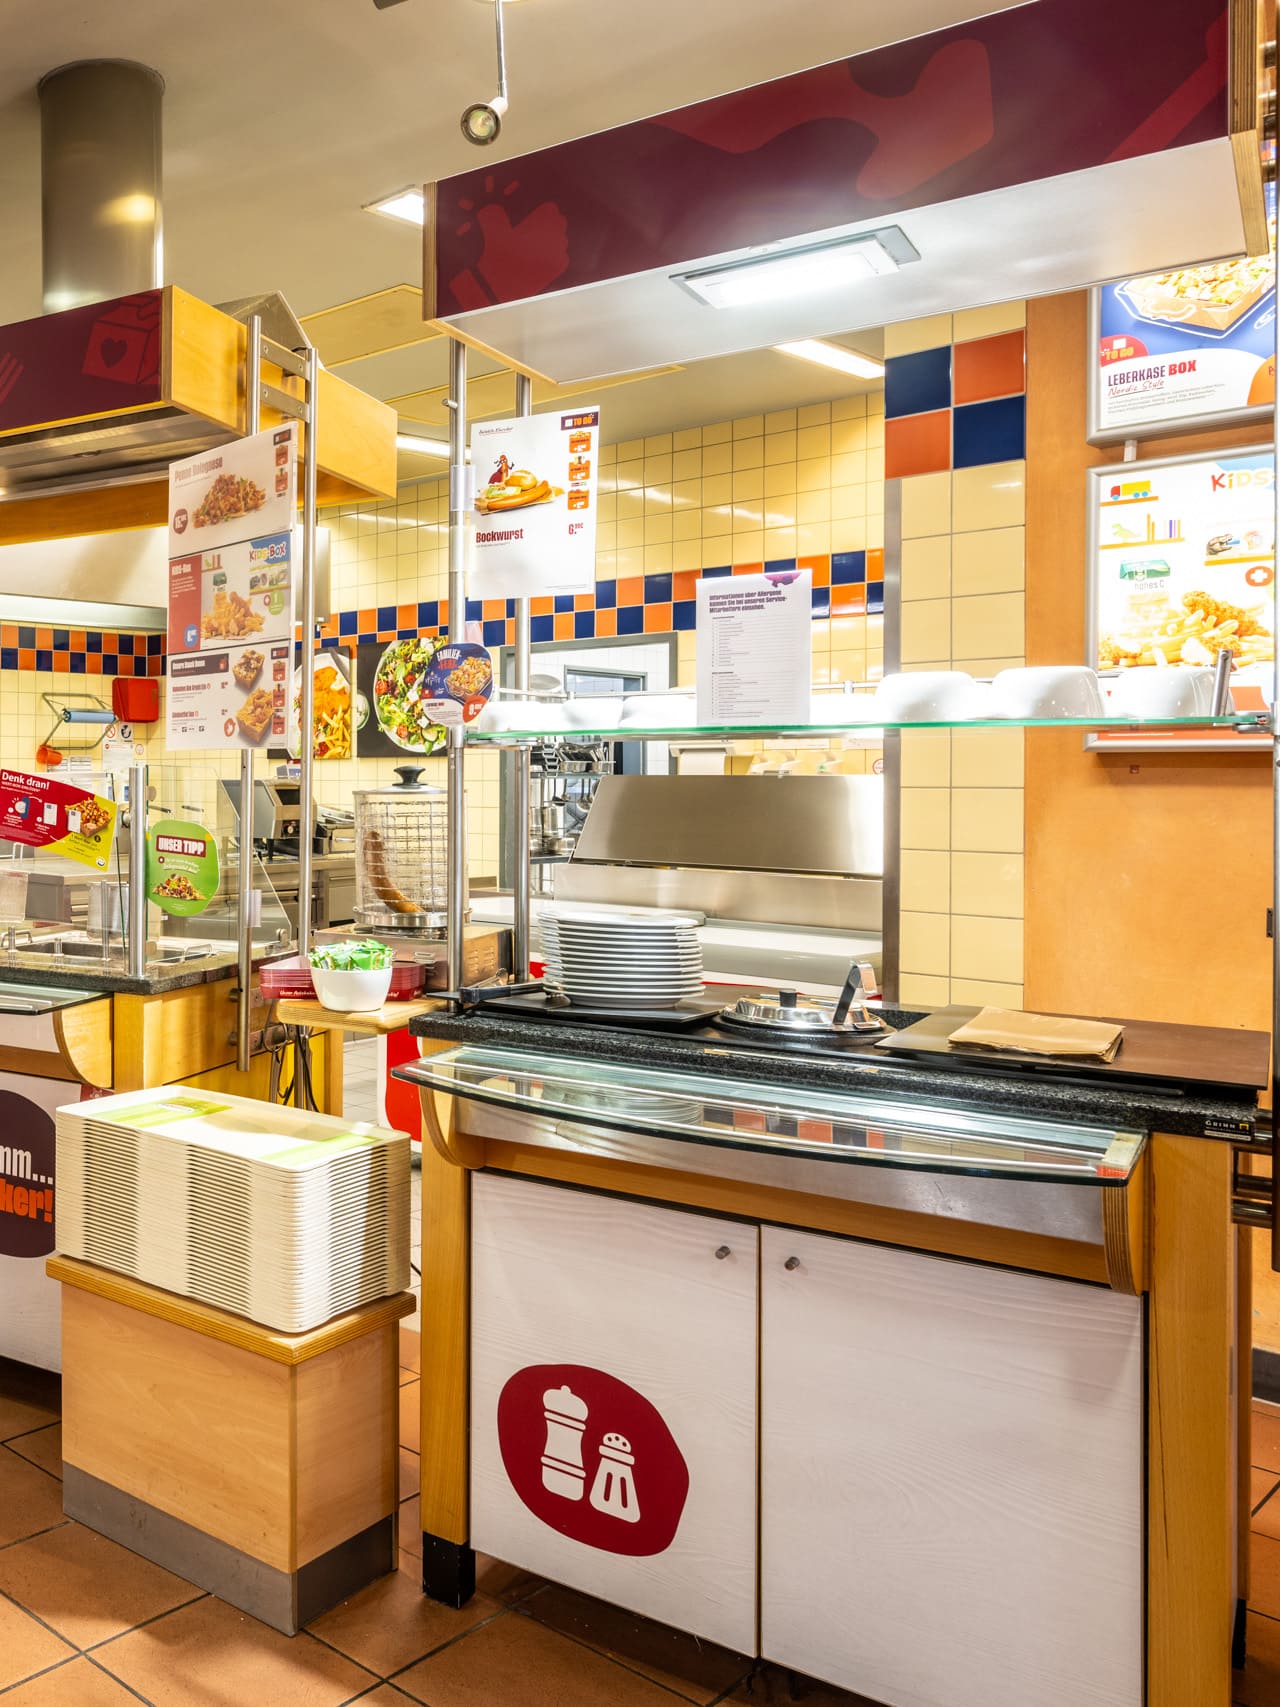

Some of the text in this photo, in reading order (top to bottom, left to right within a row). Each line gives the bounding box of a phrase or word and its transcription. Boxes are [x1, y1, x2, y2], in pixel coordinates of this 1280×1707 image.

[1168, 359, 1197, 376] BOX
[1108, 379, 1165, 397] Nordic Style
[476, 528, 524, 543] Bockwurst
[1, 772, 50, 790] Denk dran!
[157, 837, 205, 856] UNSER TIPP
